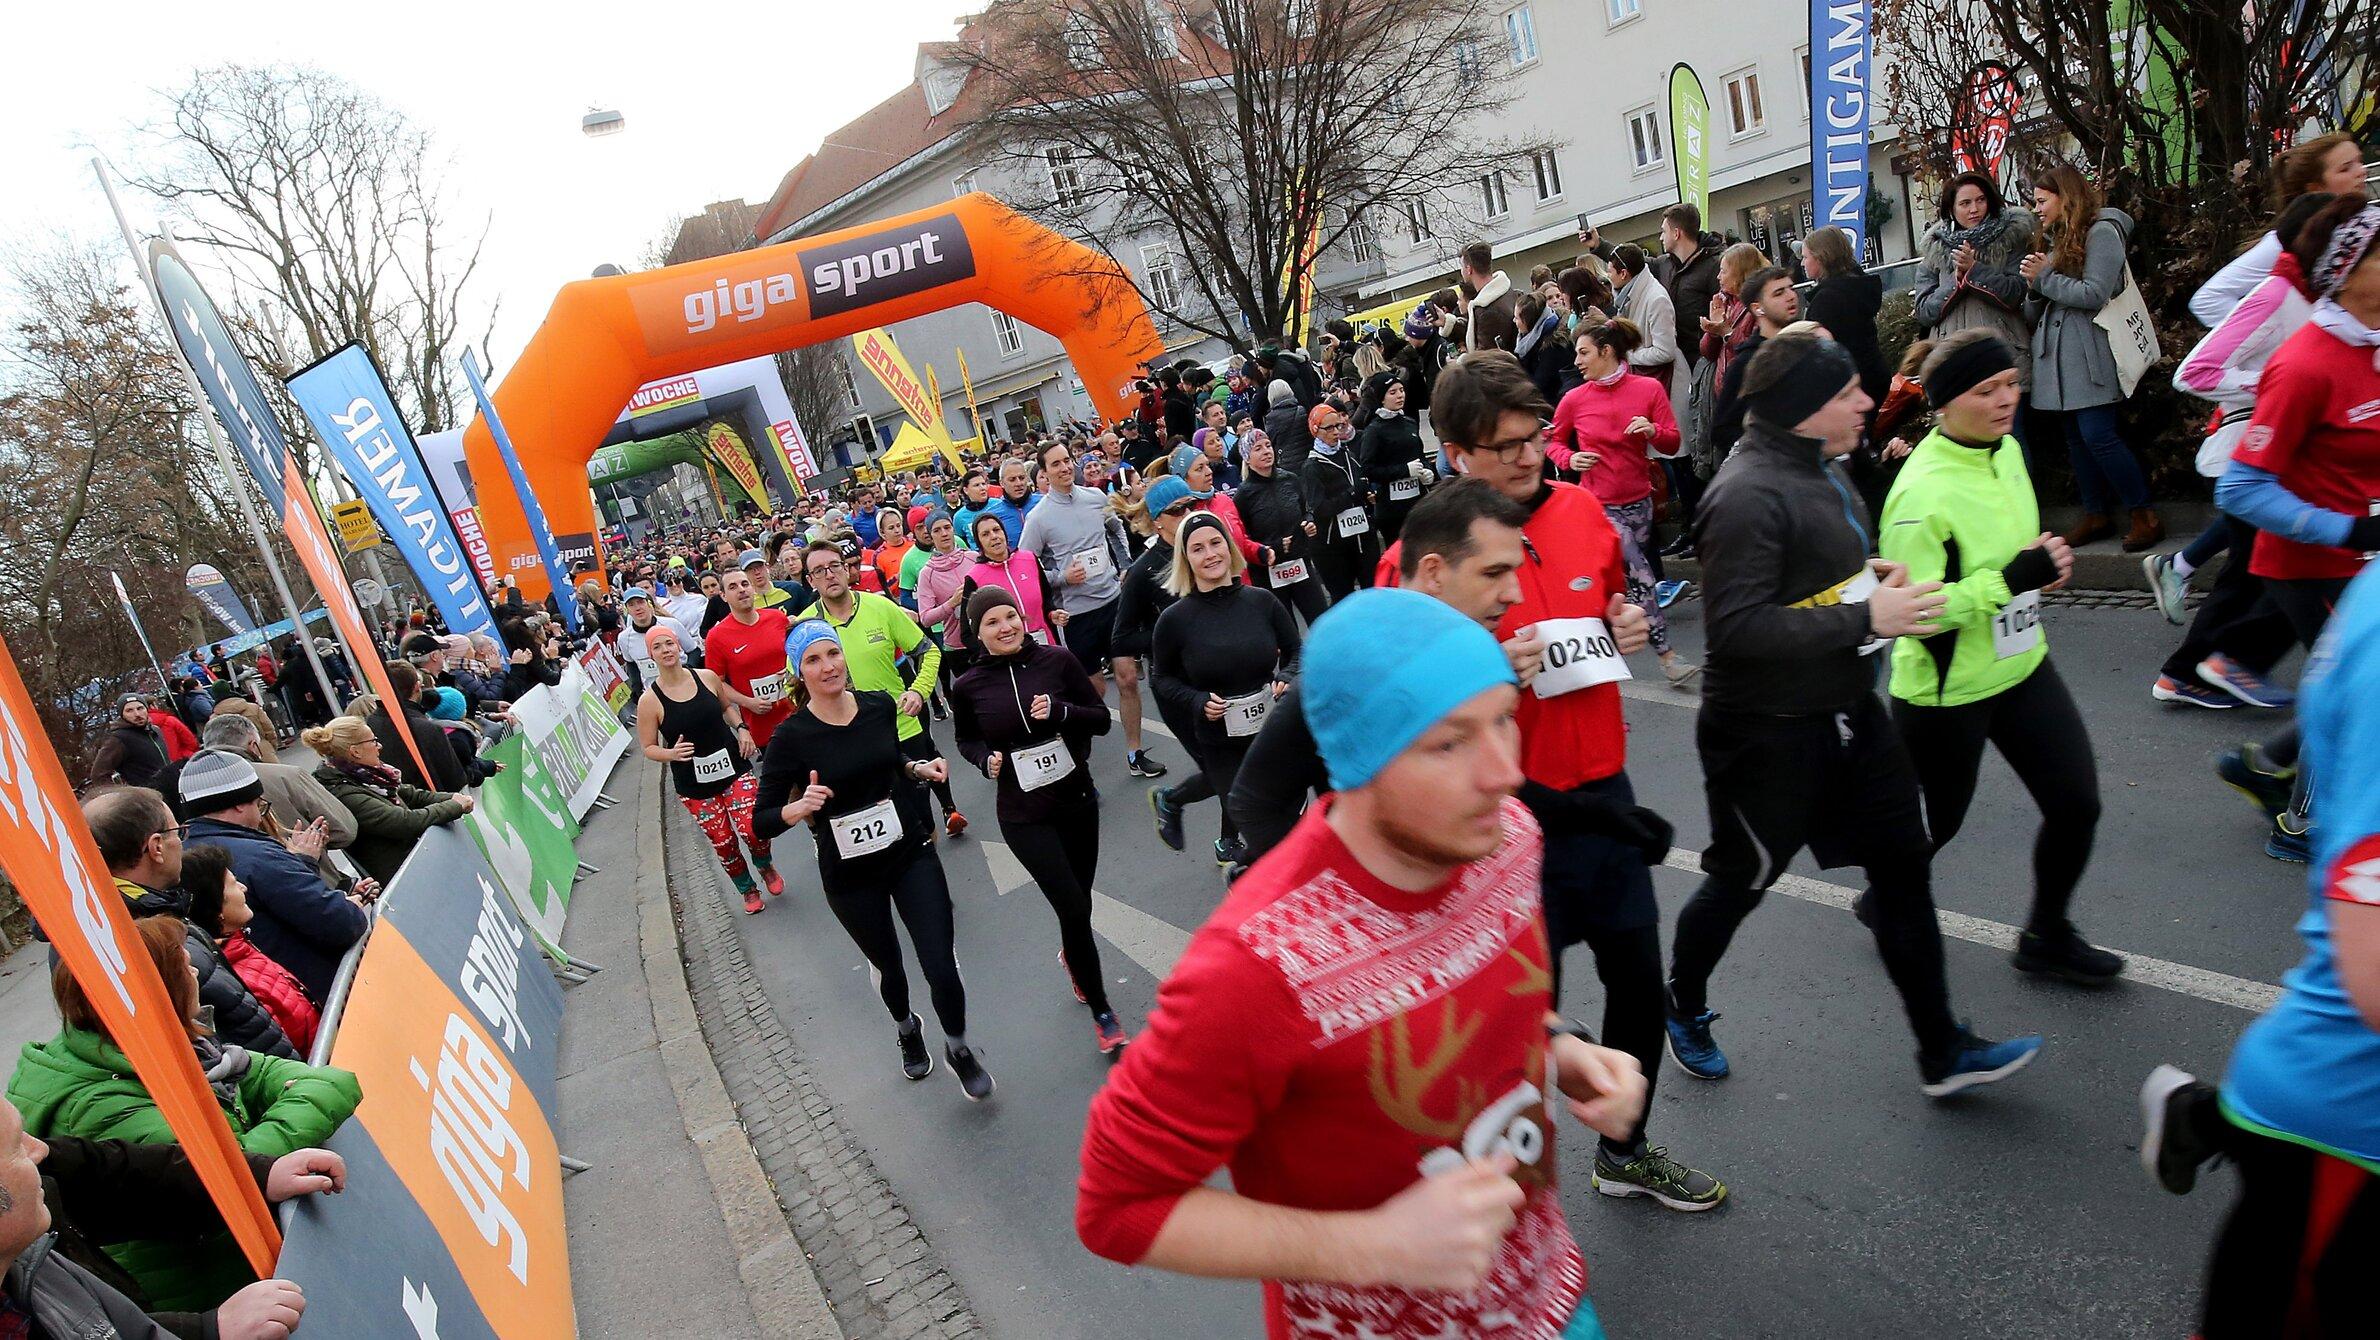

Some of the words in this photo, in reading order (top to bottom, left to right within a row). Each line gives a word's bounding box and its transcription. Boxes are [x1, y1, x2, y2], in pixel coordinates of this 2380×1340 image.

[683, 271, 797, 334] giga
[812, 231, 944, 297] sport
[633, 378, 698, 407] WOCHE
[1275, 565, 1302, 580] 1699
[1539, 635, 1615, 673] 0240
[1242, 702, 1265, 719] 158
[696, 757, 730, 775] 10213
[1034, 752, 1058, 770] 191
[850, 819, 887, 845] 212
[459, 872, 533, 1054] sport
[409, 1012, 531, 1287] giga
